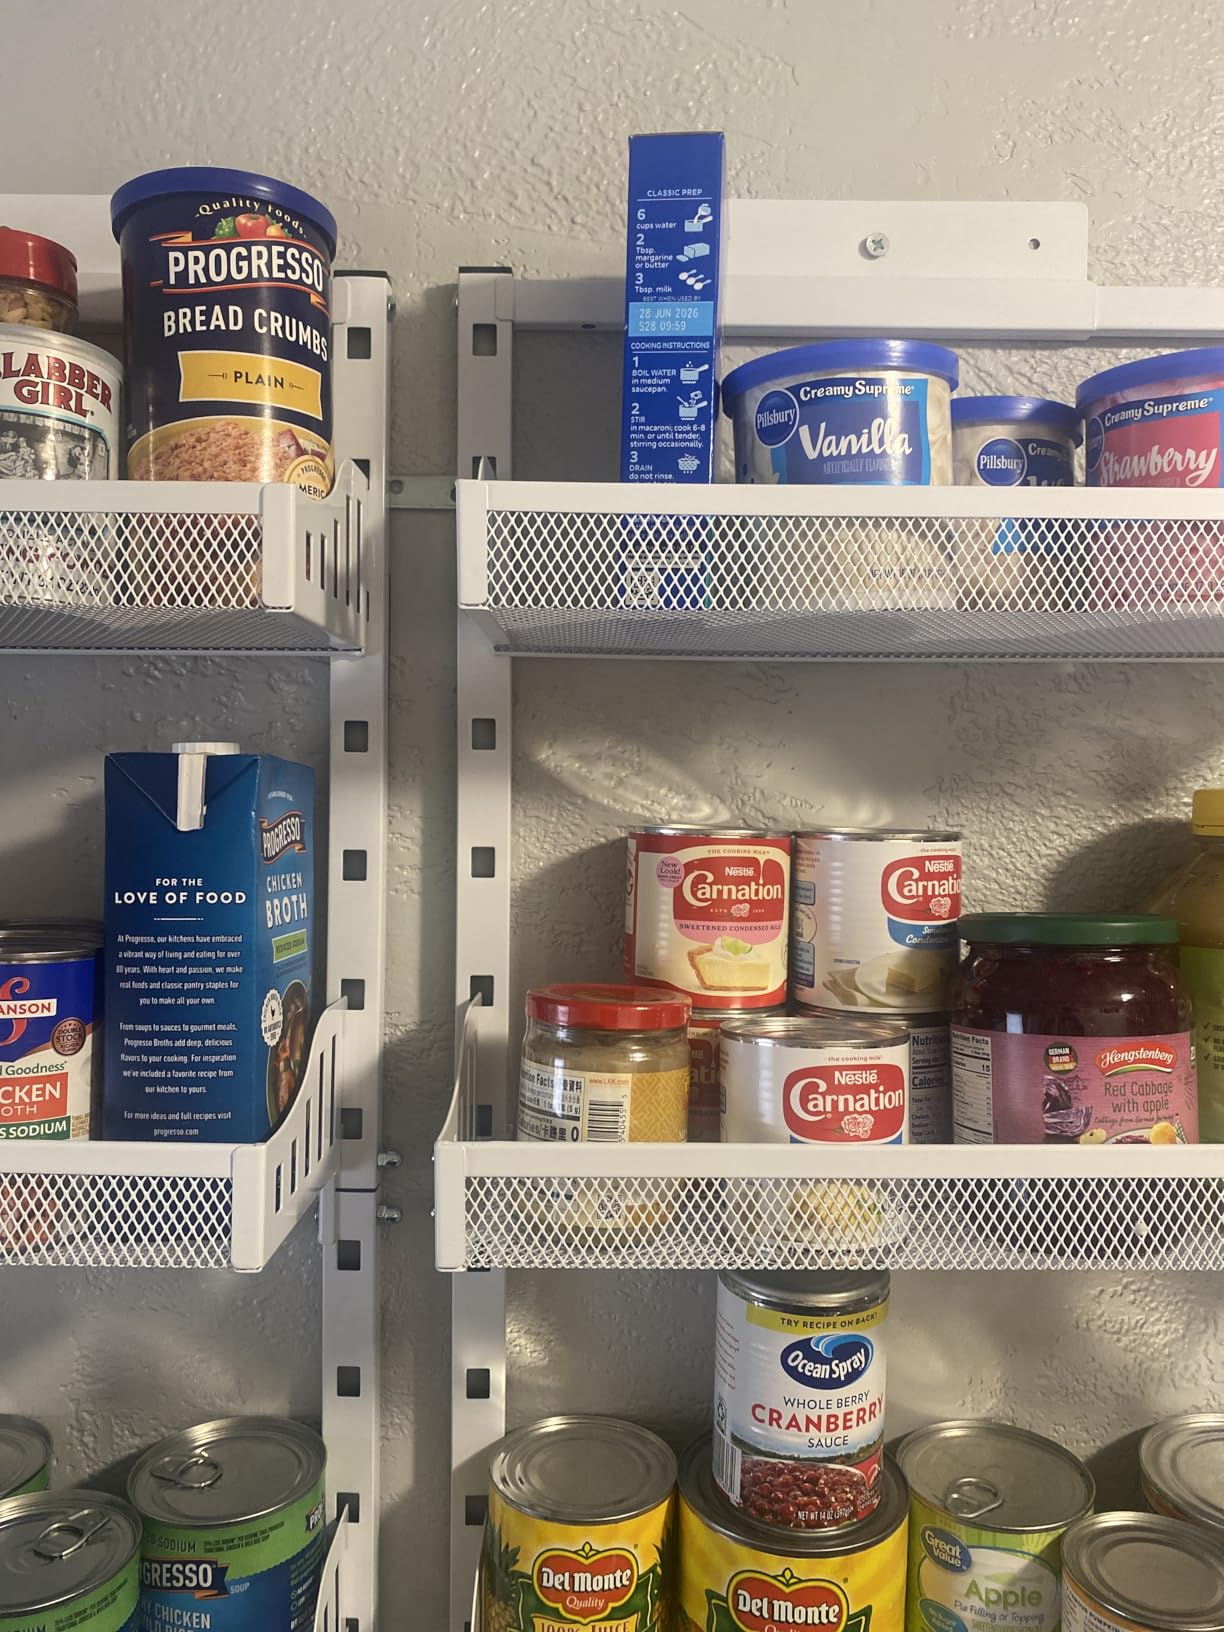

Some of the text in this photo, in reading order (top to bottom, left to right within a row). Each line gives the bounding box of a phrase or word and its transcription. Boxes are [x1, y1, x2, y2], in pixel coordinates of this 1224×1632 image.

[199, 198, 260, 215] Quality
[637, 209, 646, 220] 6
[636, 234, 644, 245] 2
[168, 245, 324, 292] PROGRESSO
[635, 273, 644, 284] 3
[635, 286, 654, 294] Tbsp.
[640, 308, 698, 318] 28 JUN 2026
[164, 305, 328, 362] BREAD CRUMBS
[661, 321, 686, 330] 09:59
[632, 356, 638, 367] 1
[0, 352, 112, 414] LABBER
[233, 370, 285, 391] PLAIN
[14, 378, 90, 418] GIRL
[800, 380, 912, 401] Creamy Suprme
[631, 403, 640, 414] 2
[1104, 398, 1208, 427] Creamy Supreme
[757, 408, 796, 430] Pillsbury
[658, 440, 704, 448] occasionally.
[675, 432, 700, 440] tender,
[799, 417, 913, 460] Vanilla
[630, 451, 638, 462] 3
[979, 454, 1024, 474] Pillsbury
[1100, 444, 1218, 487] Strawberry
[263, 817, 301, 858] PROGRESSO
[725, 867, 754, 876] Nestlé
[925, 860, 954, 872] Nestlé
[182, 878, 203, 886] THE
[267, 872, 302, 893] CHICKEN
[682, 870, 781, 907] Carnation
[114, 892, 246, 904] LOVE OF FOOD
[265, 893, 308, 929] BROTH
[212, 934, 242, 942] embraced
[972, 1036, 989, 1045] Facts
[1101, 1048, 1174, 1068] Hengstenberg
[6, 1062, 65, 1075] Goodness
[982, 1064, 990, 1072] 15
[834, 1070, 878, 1085] Nestlé
[0, 1081, 61, 1104] CKEN
[1105, 1080, 1173, 1100] Red Cabbage
[790, 1078, 903, 1122] Carnation
[1112, 1098, 1169, 1114] with apple
[1, 1105, 37, 1116] OTH
[151, 1112, 166, 1120] ideas
[168, 1112, 179, 1120] and
[181, 1112, 192, 1120] full
[193, 1112, 216, 1120] recipes
[8, 1120, 67, 1138] SODIUM
[154, 1128, 198, 1136] progresso.com
[571, 1127, 579, 1141] 0
[780, 1312, 877, 1329] TRY RECIPE ON BACK!
[787, 1348, 866, 1381] Ocean Spray
[783, 1390, 870, 1411] WHOLE BERRY
[751, 1392, 884, 1434] CRANBERRY
[807, 1435, 849, 1449] SAUCE
[798, 1511, 808, 1520] NET
[810, 1511, 818, 1520] WT
[820, 1511, 826, 1520] 14
[827, 1510, 833, 1520] OZ
[158, 1535, 196, 1552] SODIUM
[925, 1530, 961, 1558] Great
[933, 1548, 961, 1567] Value
[230, 1582, 250, 1594] SOUP
[541, 1567, 631, 1592] Del Monte
[566, 1596, 604, 1609] Quality
[965, 1580, 1042, 1610] Apple
[736, 1589, 840, 1625] Del Monte
[955, 1600, 967, 1612] Pie
[970, 1604, 997, 1621] Filling
[1011, 1612, 1044, 1624] Topping
[155, 1603, 211, 1629] CHICKEN
[592, 1621, 629, 1632] JUICE
